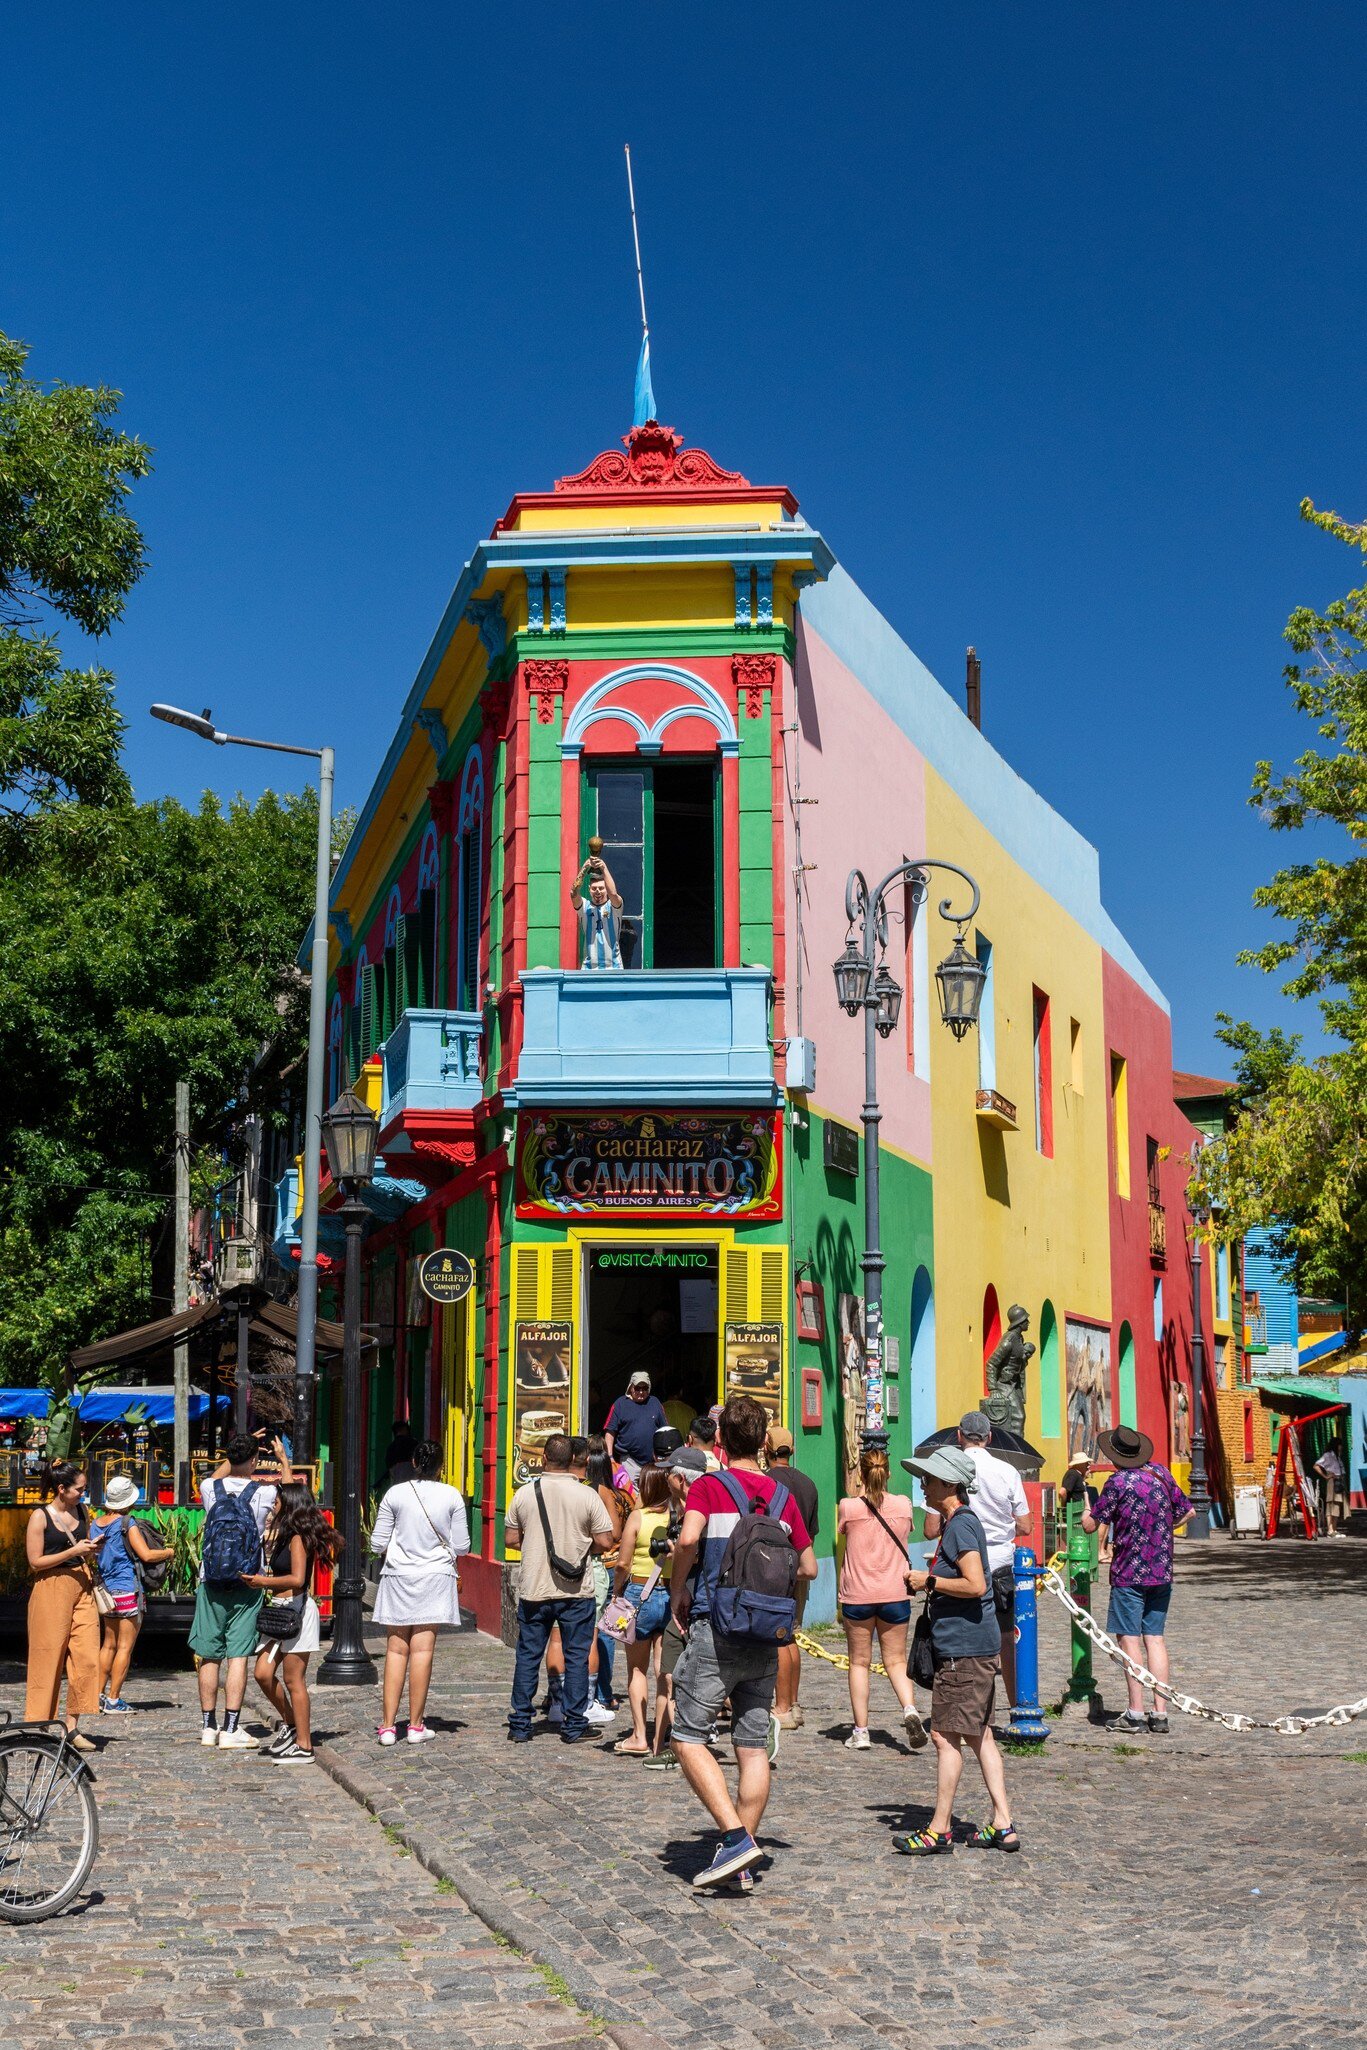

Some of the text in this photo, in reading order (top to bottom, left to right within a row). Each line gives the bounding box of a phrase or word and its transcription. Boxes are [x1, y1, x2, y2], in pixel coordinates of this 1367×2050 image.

[566, 1157, 735, 1198] CAMINITO
[604, 1197, 693, 1205] BUENOS AIRES
[598, 1253, 708, 1268] @VISITCAMINITO
[433, 1283, 461, 1291] CAMINITO
[520, 1331, 568, 1341] ALFAJOR
[731, 1333, 778, 1343] ALFAJOR
